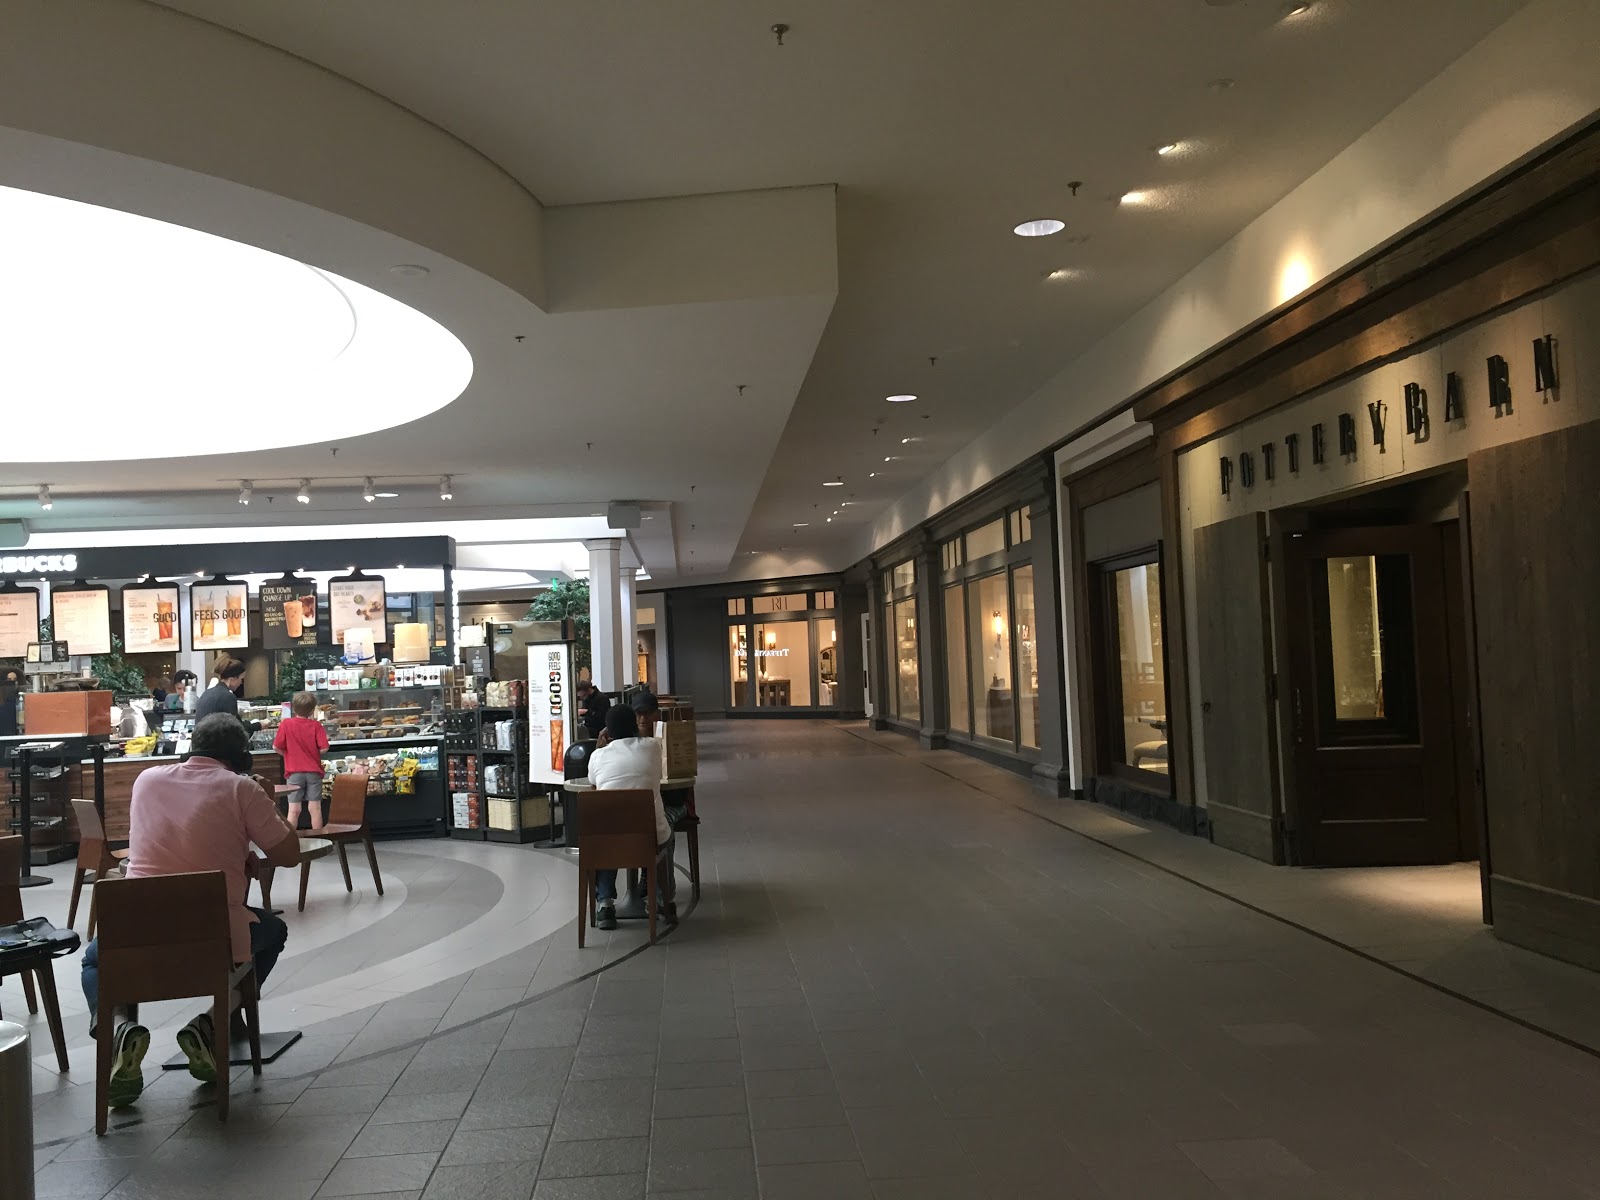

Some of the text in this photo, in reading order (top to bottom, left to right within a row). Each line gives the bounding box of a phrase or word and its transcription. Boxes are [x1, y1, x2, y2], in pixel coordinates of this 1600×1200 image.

[0, 554, 78, 573] BUCKS
[263, 594, 284, 602] CHARGE
[772, 597, 788, 611] RH
[194, 608, 246, 620] FEELS GOOD
[548, 652, 561, 661] GOOD
[549, 662, 561, 670] FEELS
[549, 671, 562, 715] GOOD
